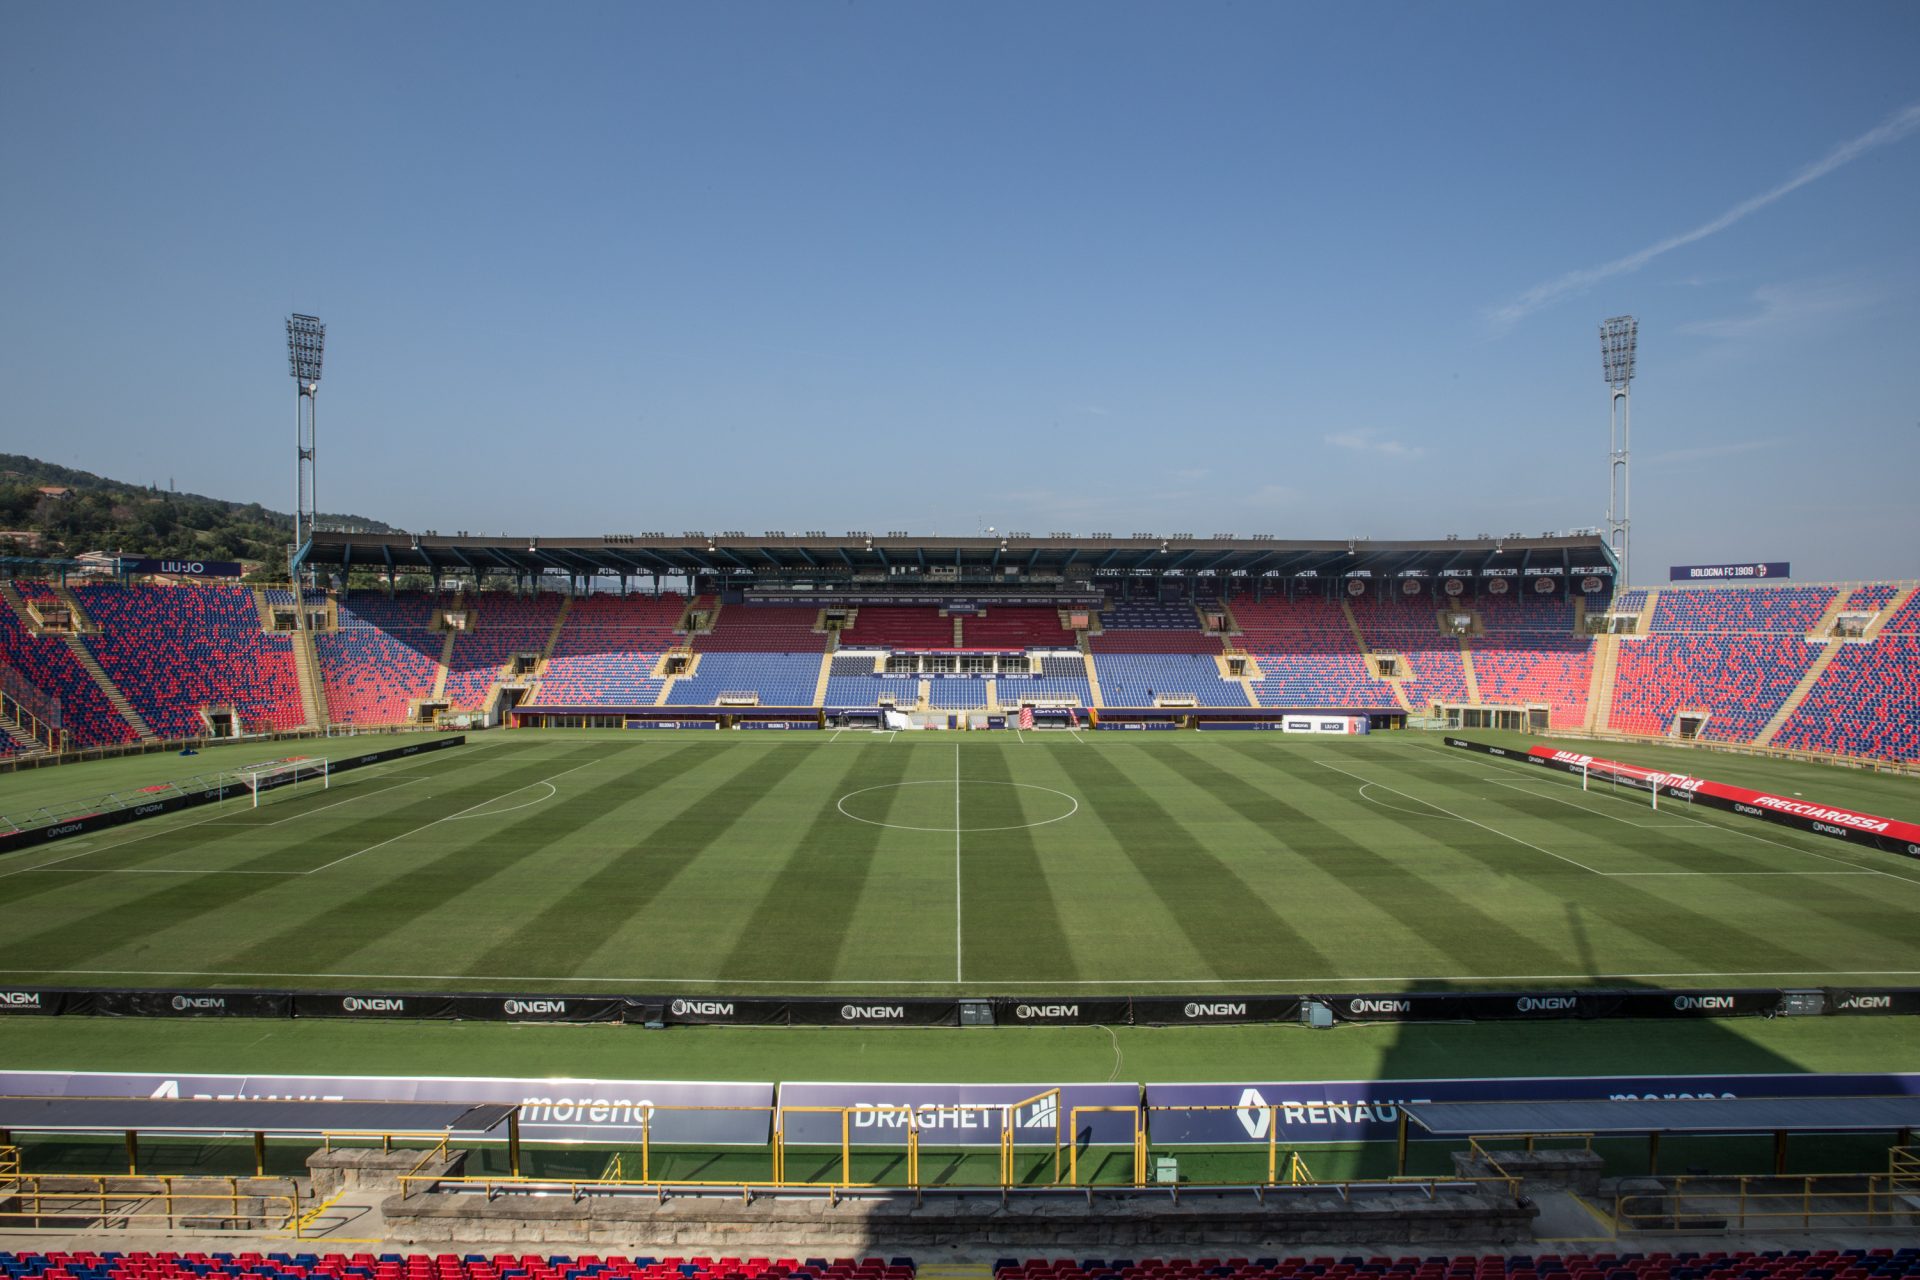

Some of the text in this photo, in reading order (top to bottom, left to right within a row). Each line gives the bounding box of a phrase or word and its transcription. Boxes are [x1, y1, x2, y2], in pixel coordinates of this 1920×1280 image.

[1691, 567, 1753, 577] BOLOGNA FC 1909
[1753, 796, 1890, 832] FRECCIAROSSA
[55, 823, 83, 836] NGM
[1819, 823, 1846, 836] NGM
[187, 998, 225, 1008] NGM
[356, 999, 403, 1011] NGM
[518, 1001, 565, 1013] NGM
[1362, 1000, 1410, 1012] NGM
[1530, 997, 1577, 1009] NGM
[1688, 996, 1734, 1008] NGM
[686, 1002, 733, 1015] NGM
[856, 1006, 904, 1018] NGM
[1030, 1005, 1078, 1017] NGM
[1199, 1003, 1246, 1015] NGM
[519, 1096, 655, 1123] moreno
[854, 1103, 1021, 1128] DRAGHETTI
[1282, 1099, 1432, 1124] RENAU
